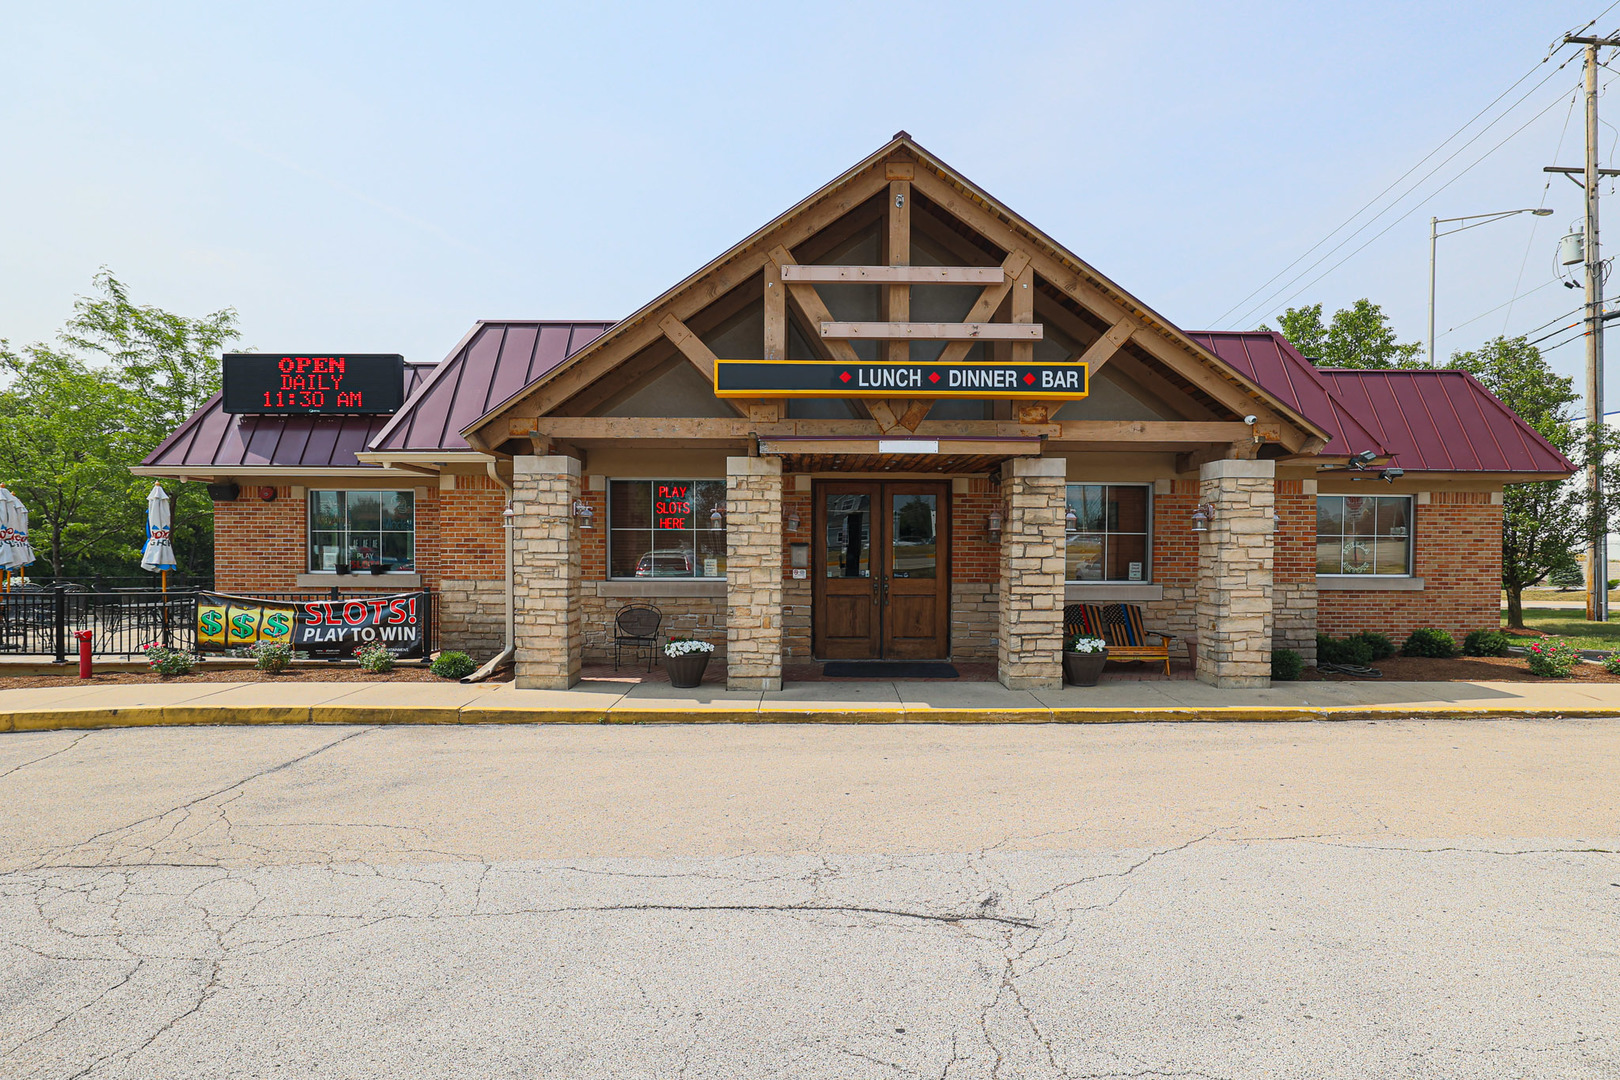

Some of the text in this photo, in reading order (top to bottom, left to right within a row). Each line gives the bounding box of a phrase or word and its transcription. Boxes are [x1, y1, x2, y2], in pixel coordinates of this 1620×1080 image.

[278, 357, 346, 373] OPEN
[280, 374, 344, 390] DAILY
[858, 368, 1079, 388] LUNCH DINNER BAR
[263, 391, 363, 407] 11:30 AM
[658, 486, 687, 498] PLAY
[656, 501, 690, 514] SLOTS
[659, 517, 686, 530] HERE
[304, 598, 417, 625] SLOTS!
[303, 626, 416, 642] PLAY TO WIN
